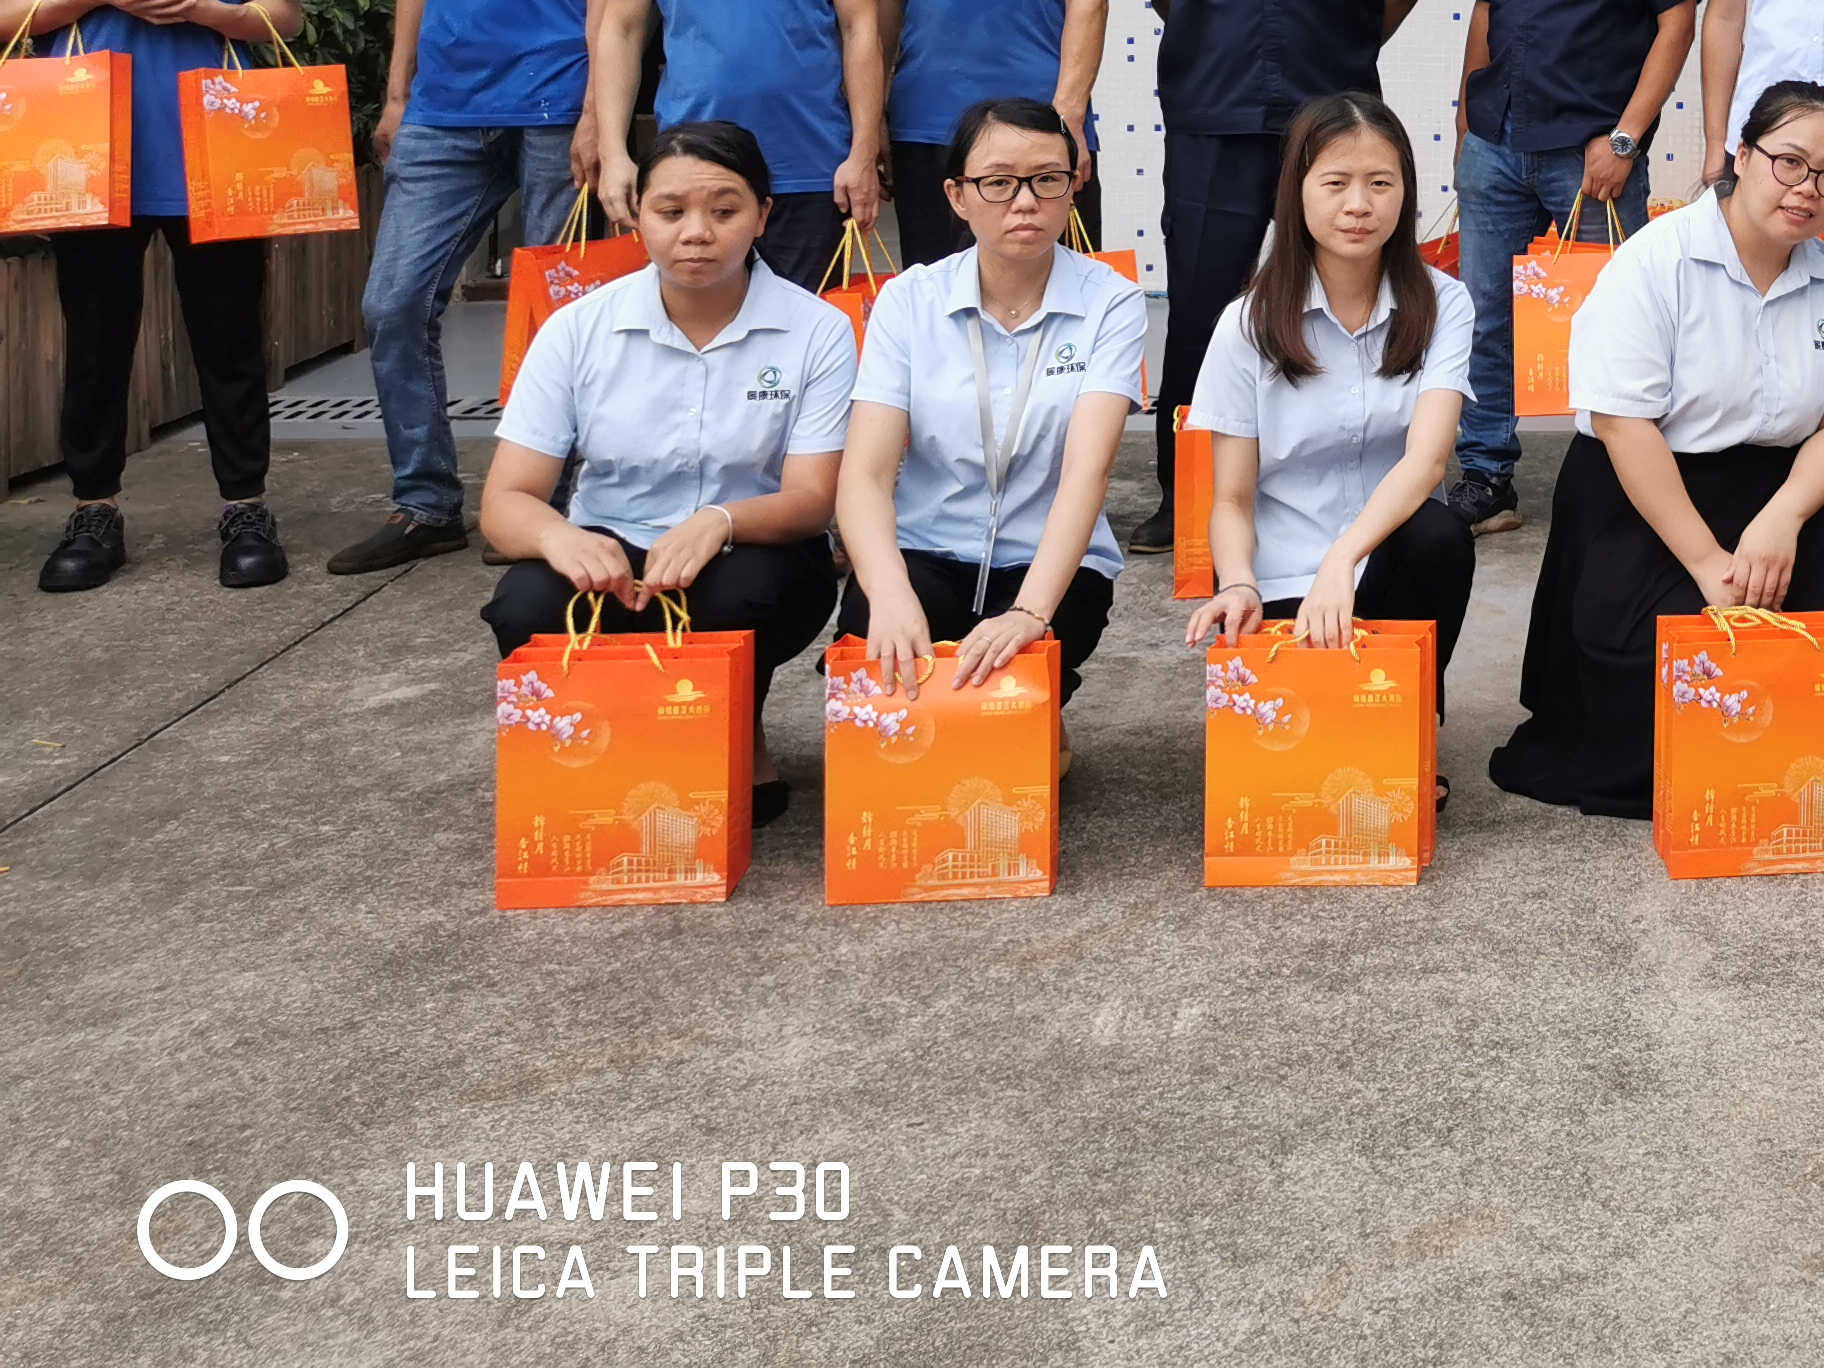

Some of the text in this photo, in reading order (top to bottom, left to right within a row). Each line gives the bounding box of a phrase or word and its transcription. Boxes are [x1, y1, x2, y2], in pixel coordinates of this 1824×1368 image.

[1046, 362, 1087, 377] 景康环保
[747, 390, 791, 402] 景康环保
